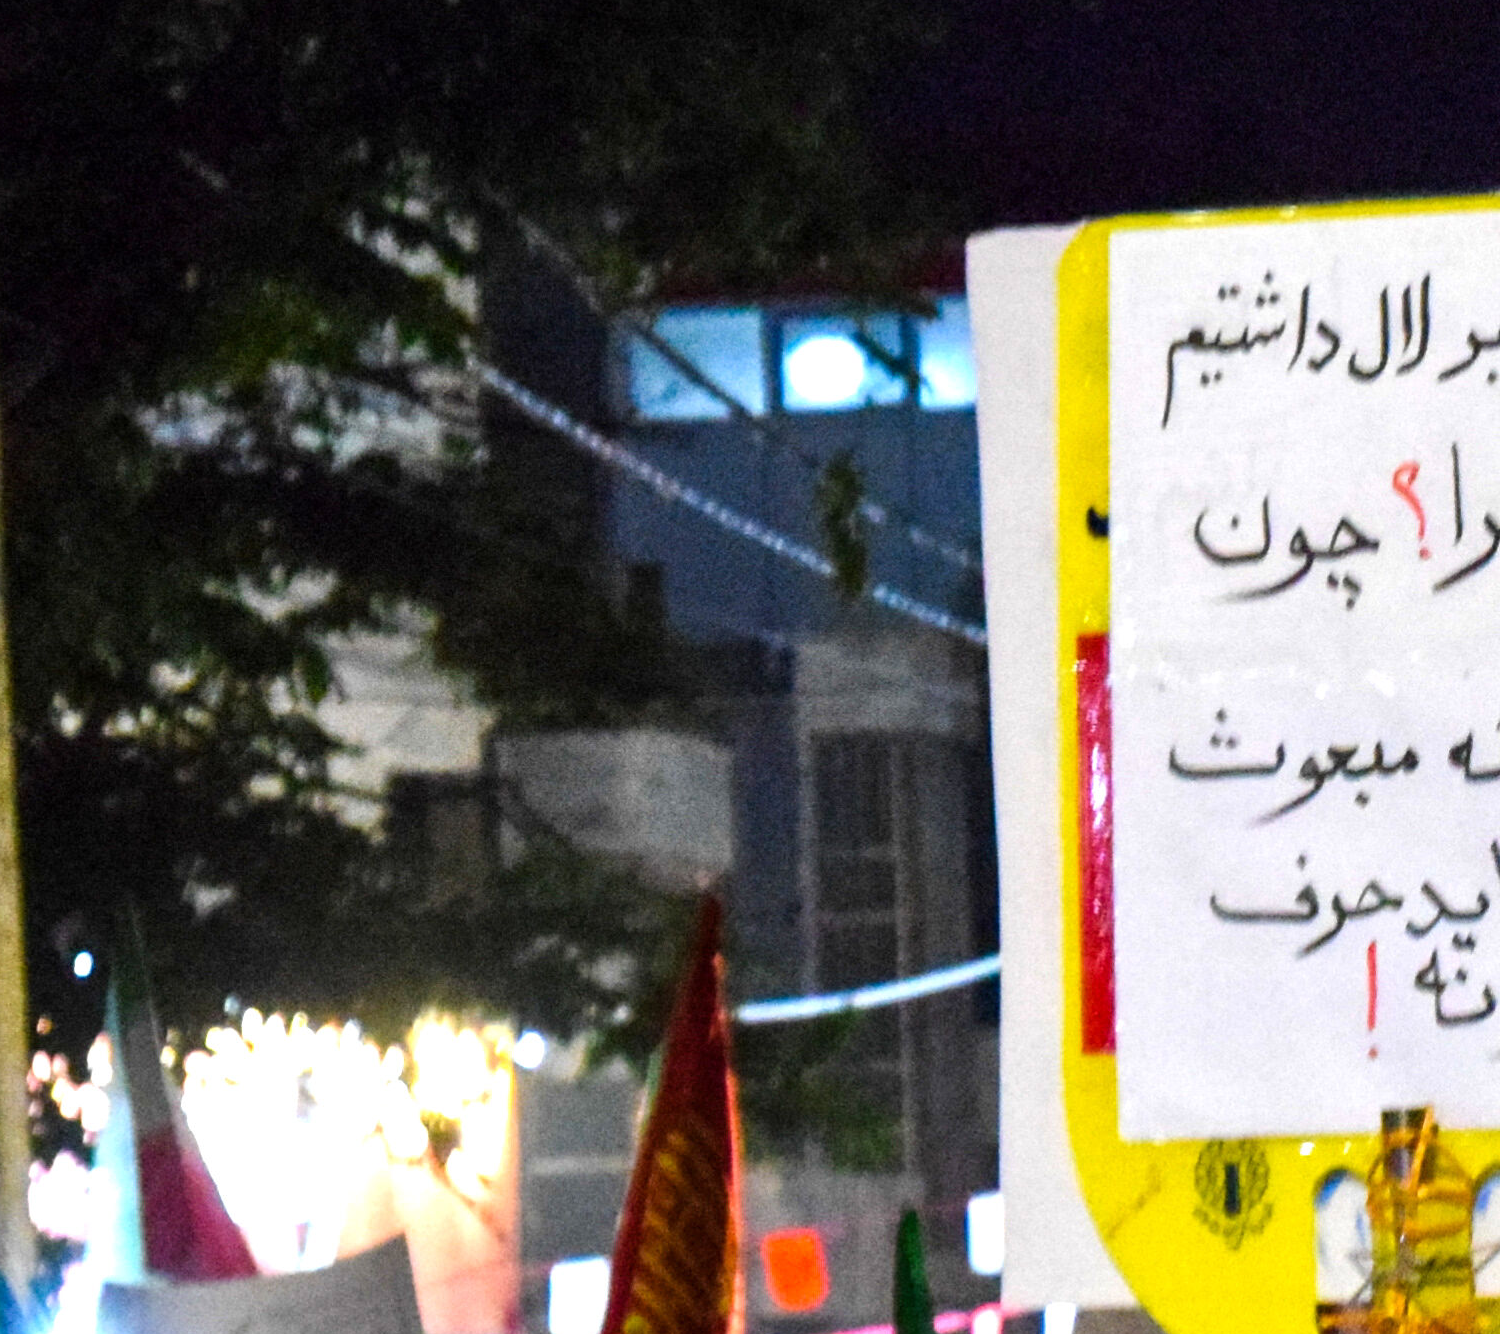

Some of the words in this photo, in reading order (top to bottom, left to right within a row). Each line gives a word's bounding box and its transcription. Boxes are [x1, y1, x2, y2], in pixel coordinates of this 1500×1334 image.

[1160, 270, 1343, 430] داشتیم
[1348, 272, 1431, 383] لال
[1193, 493, 1381, 610] چون
[1168, 707, 1421, 827] مبعوث
[1209, 854, 1406, 961] حرف
